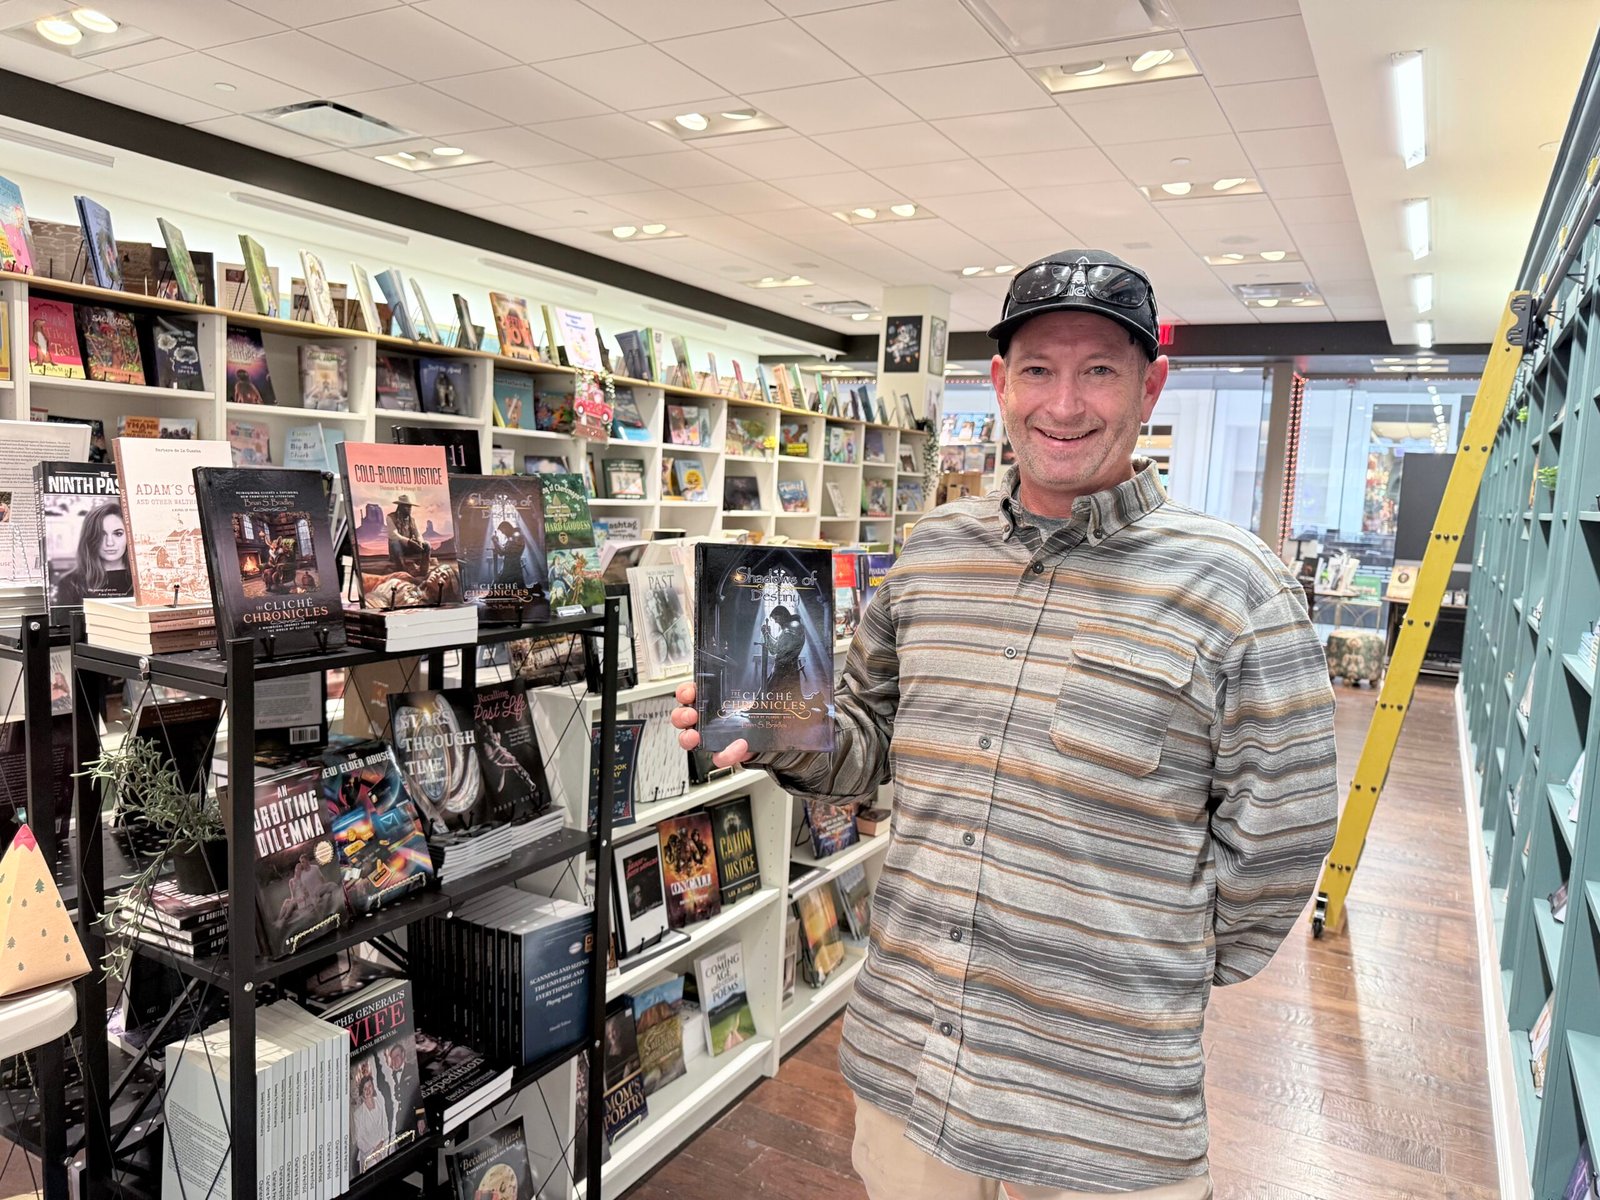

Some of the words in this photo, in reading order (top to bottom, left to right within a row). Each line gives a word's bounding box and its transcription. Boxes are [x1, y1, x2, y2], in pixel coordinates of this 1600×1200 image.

[50, 342, 76, 357] Tavi
[354, 464, 412, 484] COLD-BLOODED
[413, 467, 442, 485] JUSTICE
[48, 476, 94, 494] NINTH
[271, 498, 294, 507] Bradley
[520, 495, 532, 506] of
[648, 574, 674, 590] PAST
[734, 566, 798, 585] Shadows
[802, 570, 818, 586] of
[264, 597, 314, 611] CLICHÉ
[751, 589, 800, 607] Destiny
[243, 606, 329, 624] CHRONICLES
[478, 690, 510, 704] Recalling
[723, 700, 806, 710] CHRONICLES
[742, 690, 793, 700] CLICHÉ
[502, 694, 527, 721] Life
[400, 711, 450, 728] STARS
[400, 730, 476, 752] THROUGH
[339, 758, 365, 773] ELDER
[365, 750, 391, 766] ABUSE
[404, 757, 444, 776] TIME
[277, 784, 288, 799] AN
[254, 790, 319, 832] ORBITING
[255, 812, 326, 858] DILEMMA
[720, 829, 752, 860] CAJUN
[724, 854, 756, 882] JUSTICE
[530, 969, 558, 985] SCANNING
[558, 965, 571, 974] AND
[705, 952, 739, 978] COMING
[546, 974, 572, 988] UNIVERSE
[572, 969, 584, 977] AND
[536, 983, 570, 1002] EVERYTHING
[713, 982, 739, 1003] POEMS
[334, 1013, 354, 1027] THE
[355, 990, 405, 1019] GENERAL'S
[350, 1048, 360, 1058] THE
[360, 1042, 374, 1053] FINAL
[374, 1029, 398, 1045] BETRAYAL
[605, 1079, 640, 1113] MOM'S
[604, 1090, 645, 1130] POETRY
[463, 1144, 497, 1171] Becoming
[501, 1126, 521, 1146] Hazel
